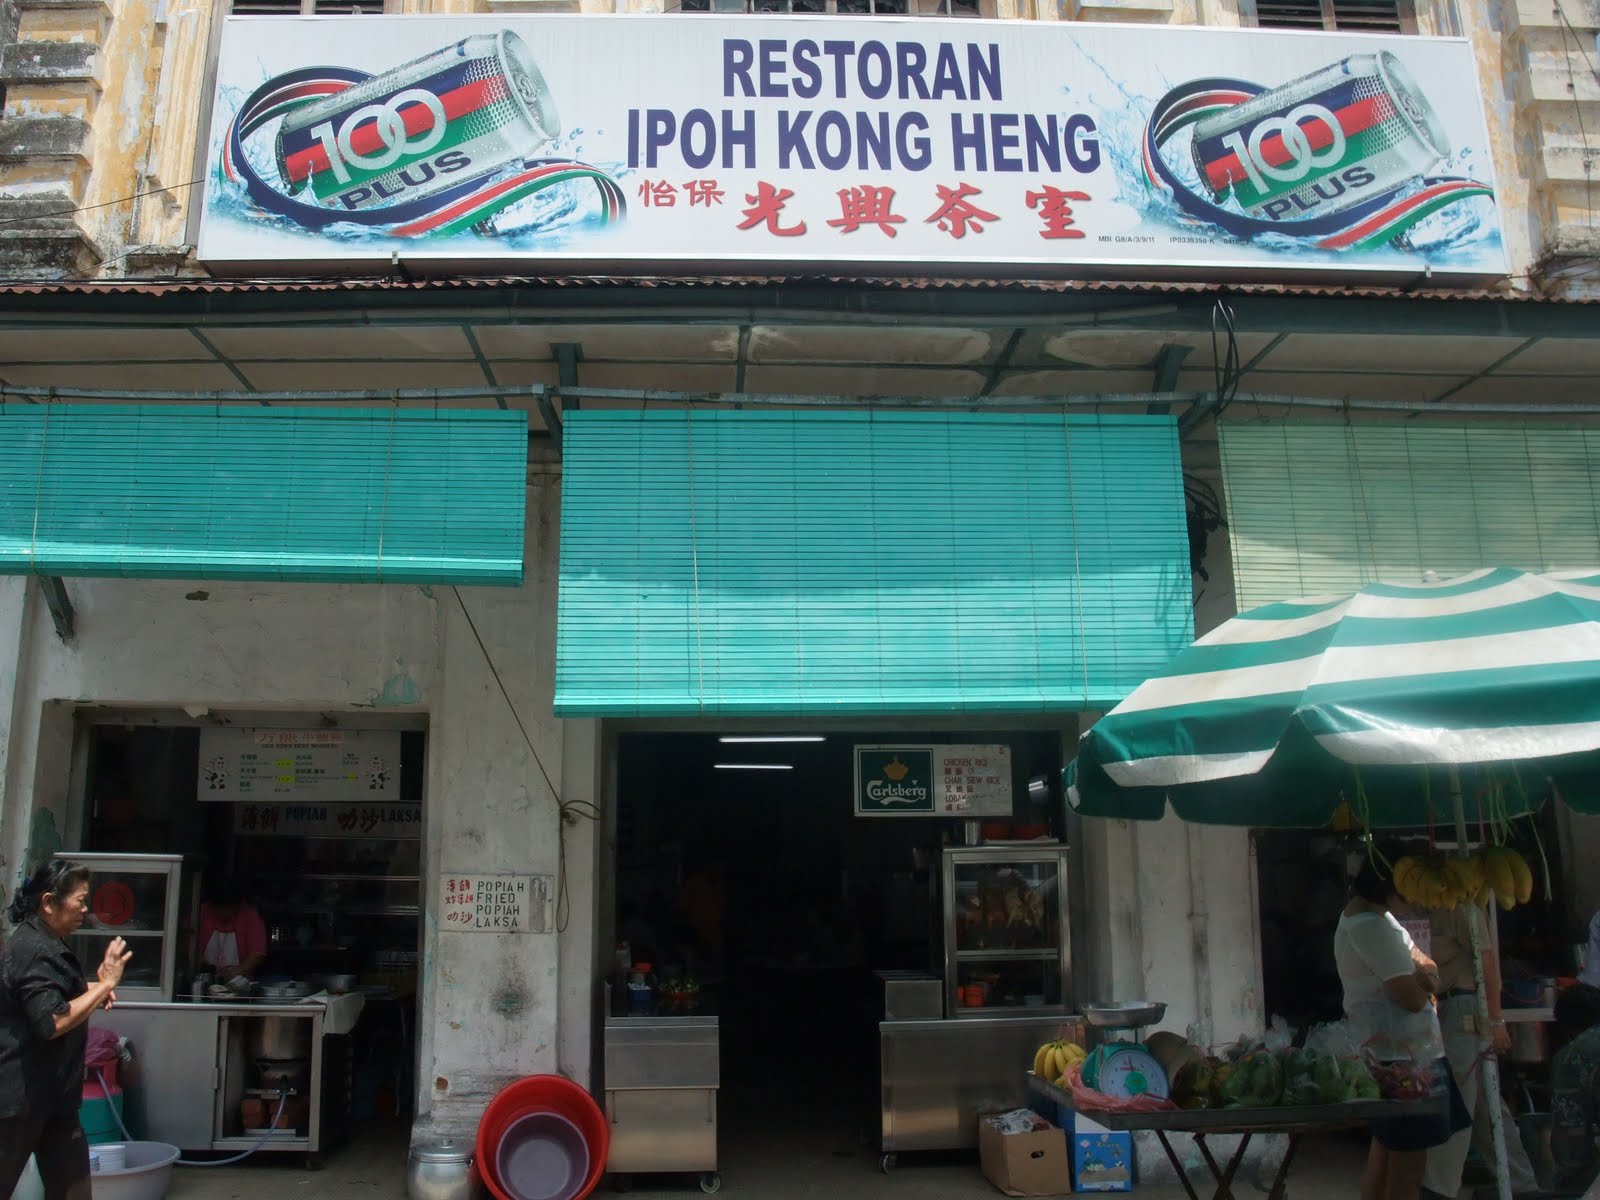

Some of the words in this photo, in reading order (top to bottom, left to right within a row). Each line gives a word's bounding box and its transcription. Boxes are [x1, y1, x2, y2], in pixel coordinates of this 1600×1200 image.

[722, 39, 1003, 101] RESTORAN
[310, 88, 447, 184] 100
[627, 108, 756, 169] IPOH
[777, 110, 932, 172] KONG
[951, 112, 1101, 174] HENG
[1222, 103, 1346, 195] 100
[338, 150, 472, 210] PLUS
[1262, 166, 1376, 220] PLUS
[638, 179, 725, 209] 怡保
[735, 180, 1093, 240] 光興茶室
[1098, 235, 1112, 243] MBI
[944, 758, 971, 767] CHICKEN
[944, 776, 962, 784] CHAR
[986, 776, 1001, 785] RICE
[867, 780, 926, 801] Carlsberg
[285, 807, 328, 821] POPIAH
[380, 807, 421, 822] LAKSA
[477, 880, 525, 893] POPIAH
[476, 892, 516, 904] FRIED
[476, 904, 520, 916] POPIAH
[476, 916, 519, 928] LAKSA
